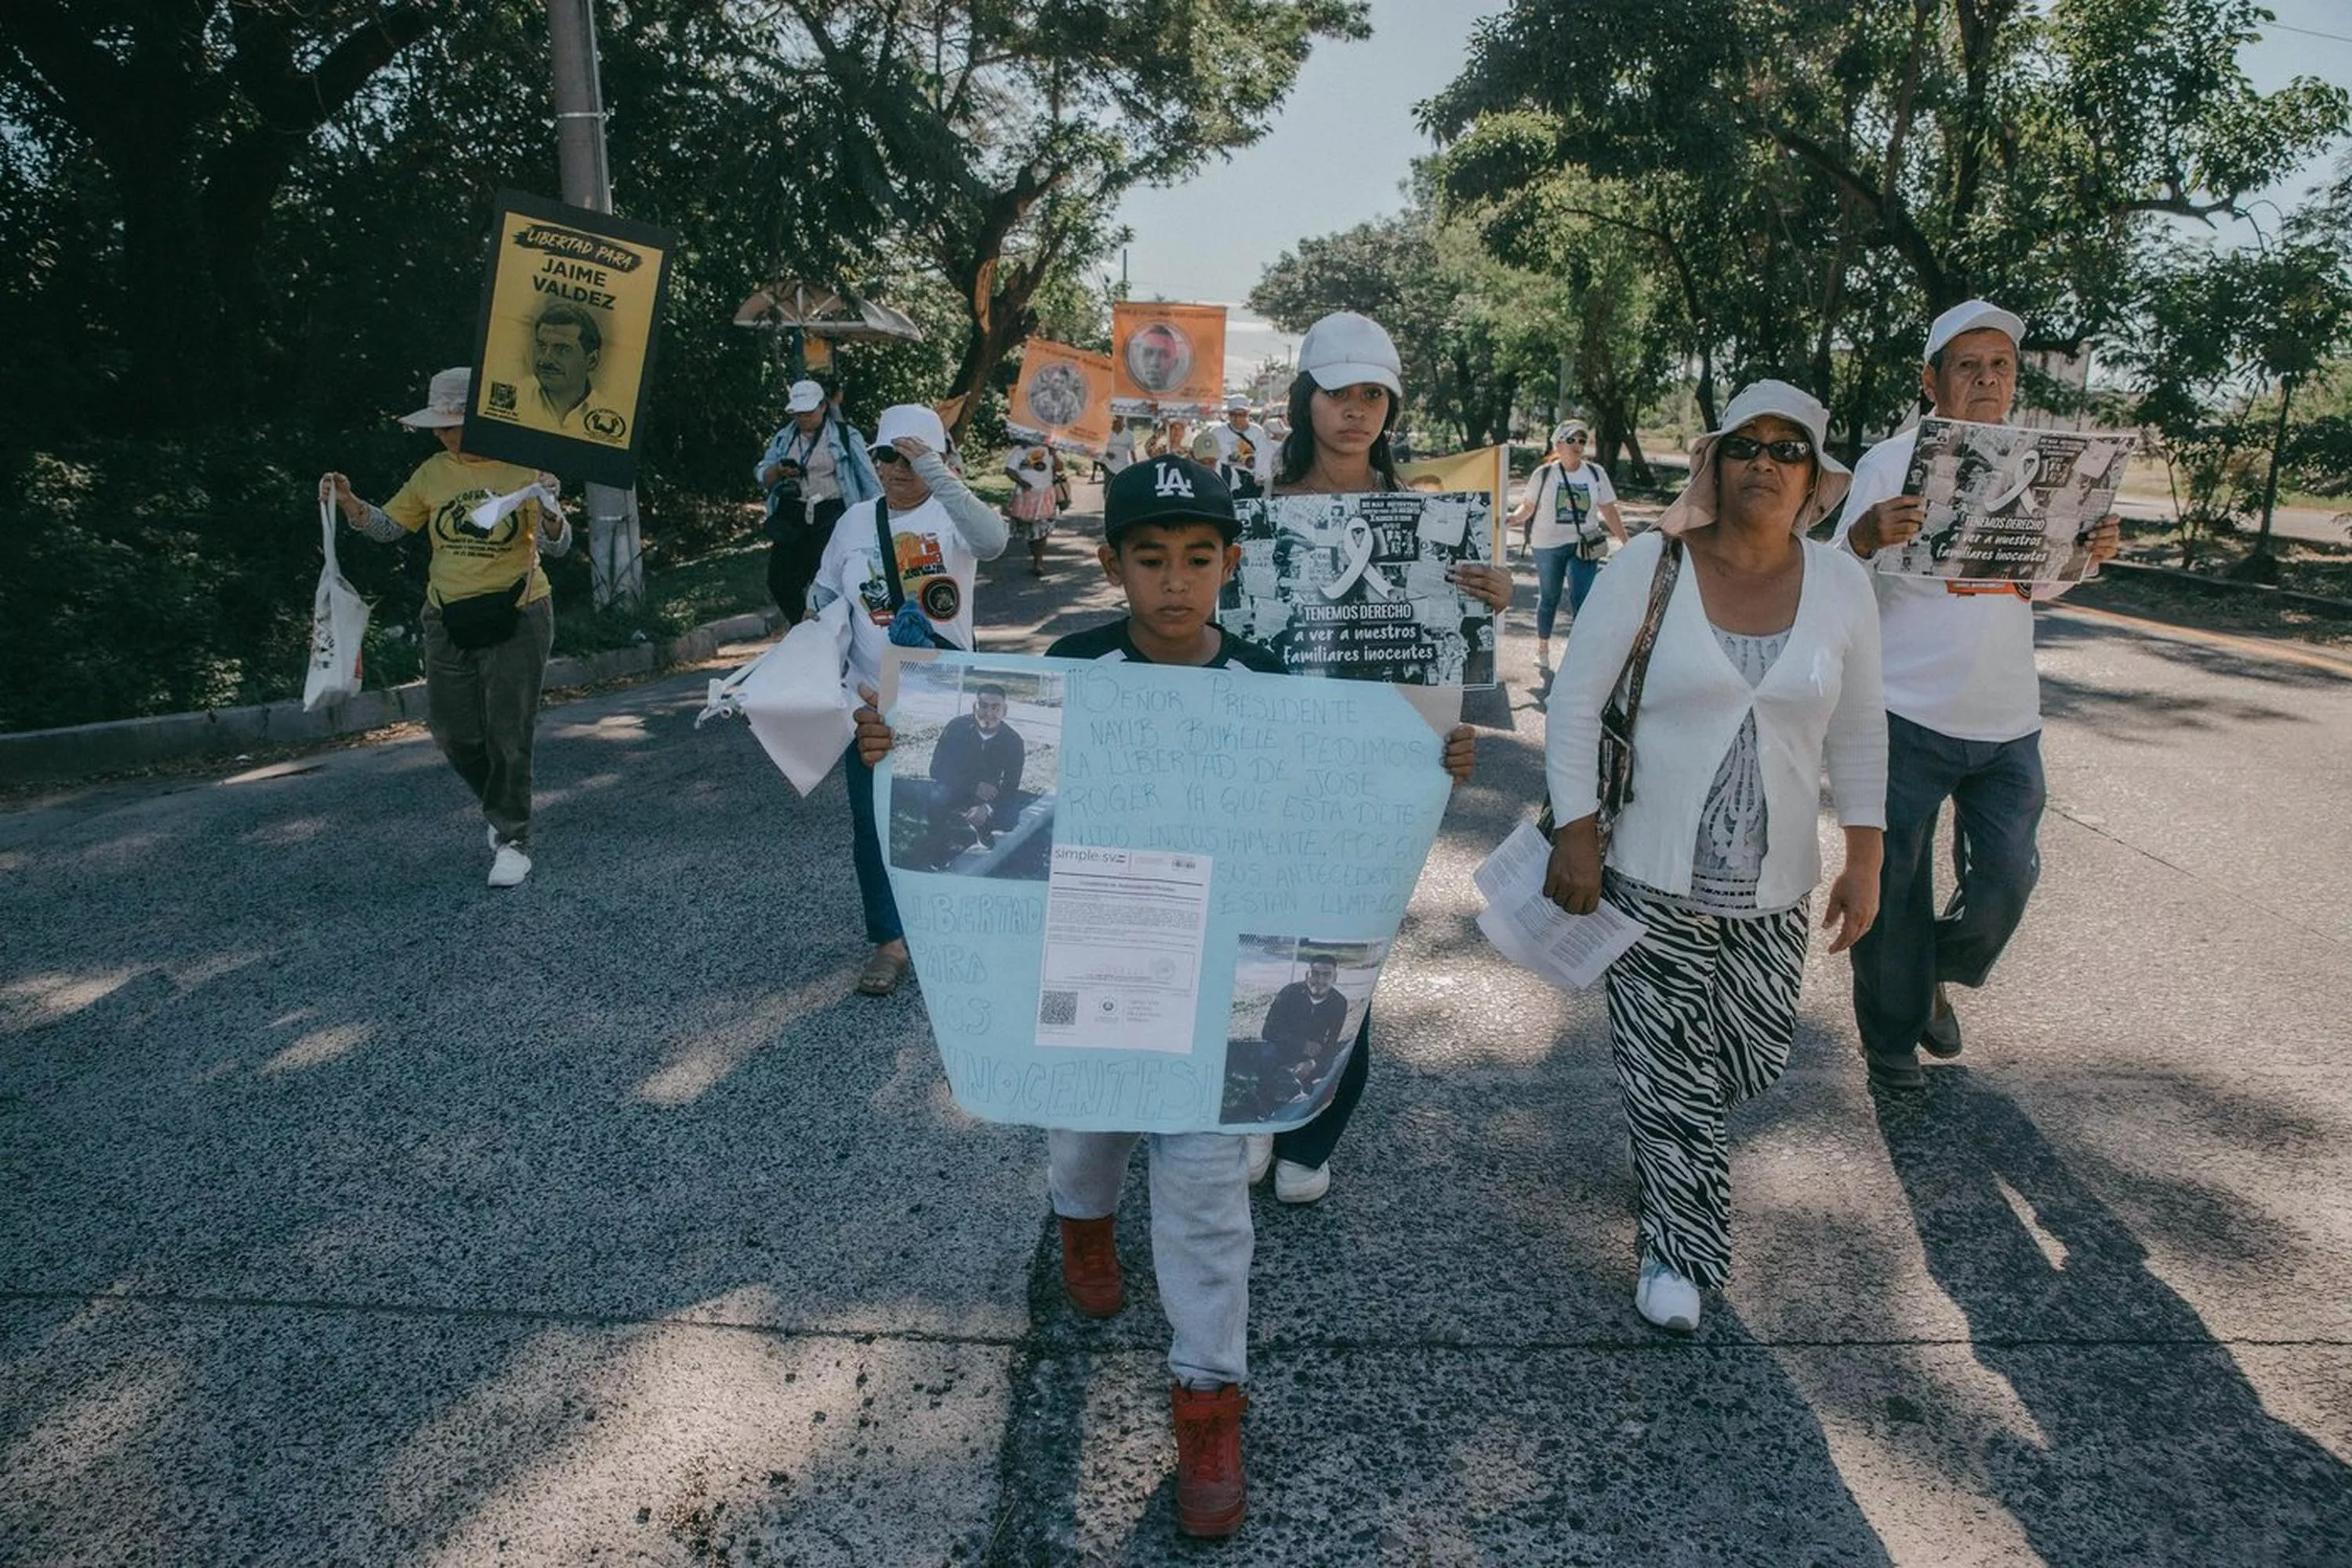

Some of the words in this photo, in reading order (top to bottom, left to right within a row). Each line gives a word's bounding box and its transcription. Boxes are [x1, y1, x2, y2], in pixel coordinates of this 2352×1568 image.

[526, 227, 593, 256] LIBERTAD
[596, 245, 633, 270] PARA
[542, 258, 608, 288] JAIME
[532, 275, 618, 311] VALDEZ
[1154, 462, 1196, 498] LA
[2005, 517, 2045, 531] DERECHO
[1994, 534, 2042, 546] nuestros
[1994, 548, 2049, 562] inocentes
[1304, 605, 1359, 622] TENEMOS
[1359, 603, 1413, 619] DERECHO
[1294, 630, 1305, 642] a
[1308, 629, 1334, 641] ver
[1339, 629, 1350, 641] a
[1354, 624, 1417, 641] nuestros
[1364, 644, 1434, 662] inocentes
[1090, 717, 1160, 749] NAYIB
[1296, 731, 1428, 771] PEDIMOS
[1065, 748, 1092, 779] LA
[1107, 748, 1237, 780] LIBERTAD
[1249, 756, 1290, 784] DE
[1063, 782, 1163, 818] ROGER
[1220, 786, 1272, 820] QUE
